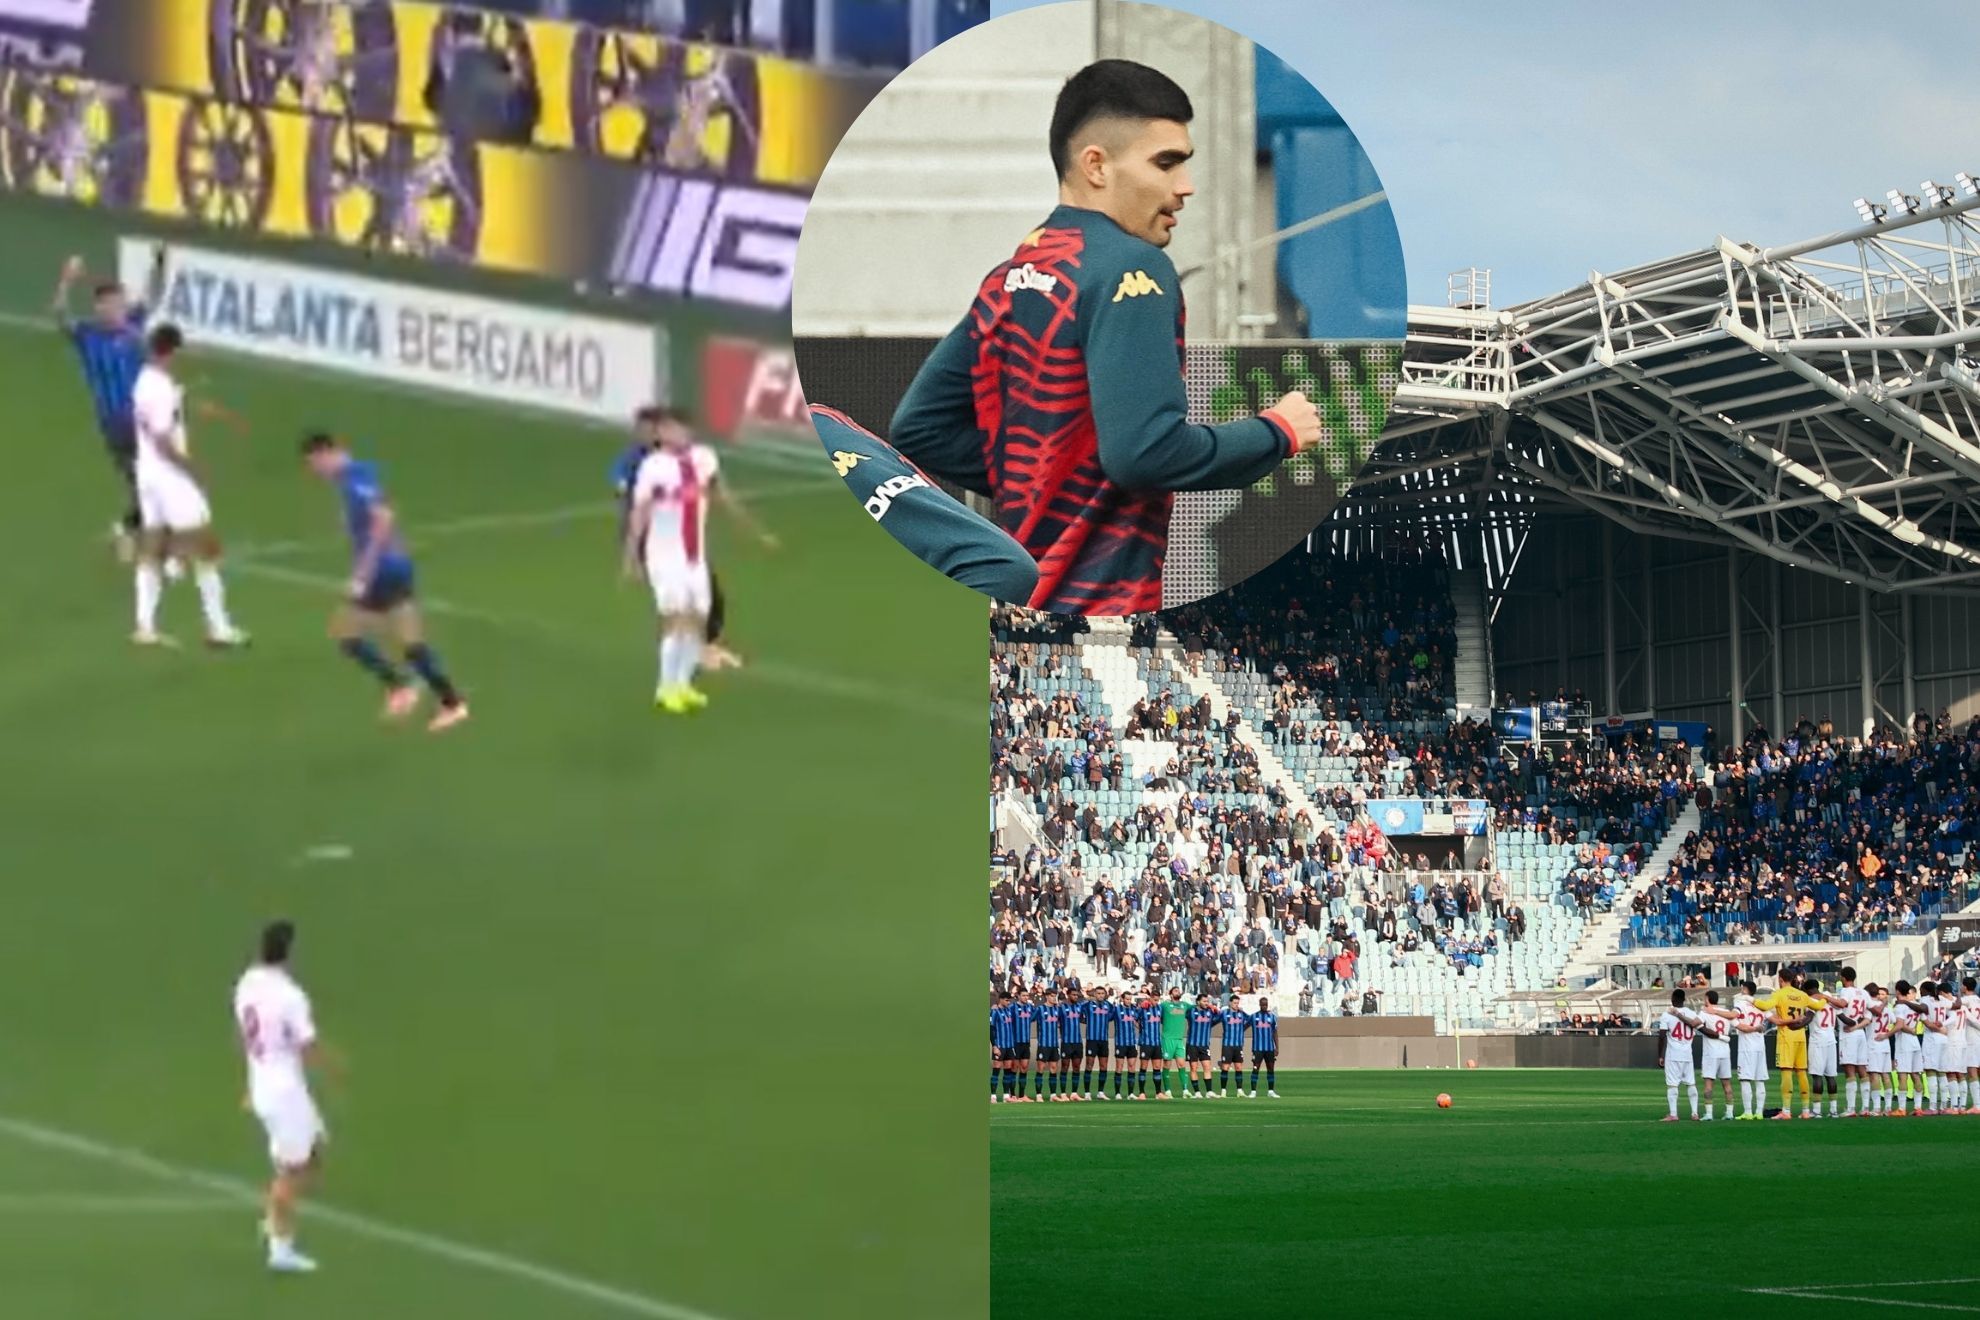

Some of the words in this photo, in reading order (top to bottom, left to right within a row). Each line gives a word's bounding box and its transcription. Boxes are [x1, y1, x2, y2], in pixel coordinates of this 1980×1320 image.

[168, 266, 381, 359] ATALANTA
[397, 306, 606, 400] BERGAMO
[1820, 1007, 1834, 1028] 21
[1849, 999, 1866, 1019] 34
[1671, 1021, 1694, 1041] 40
[1715, 1019, 1725, 1034] 8
[1874, 1013, 1890, 1034] 32
